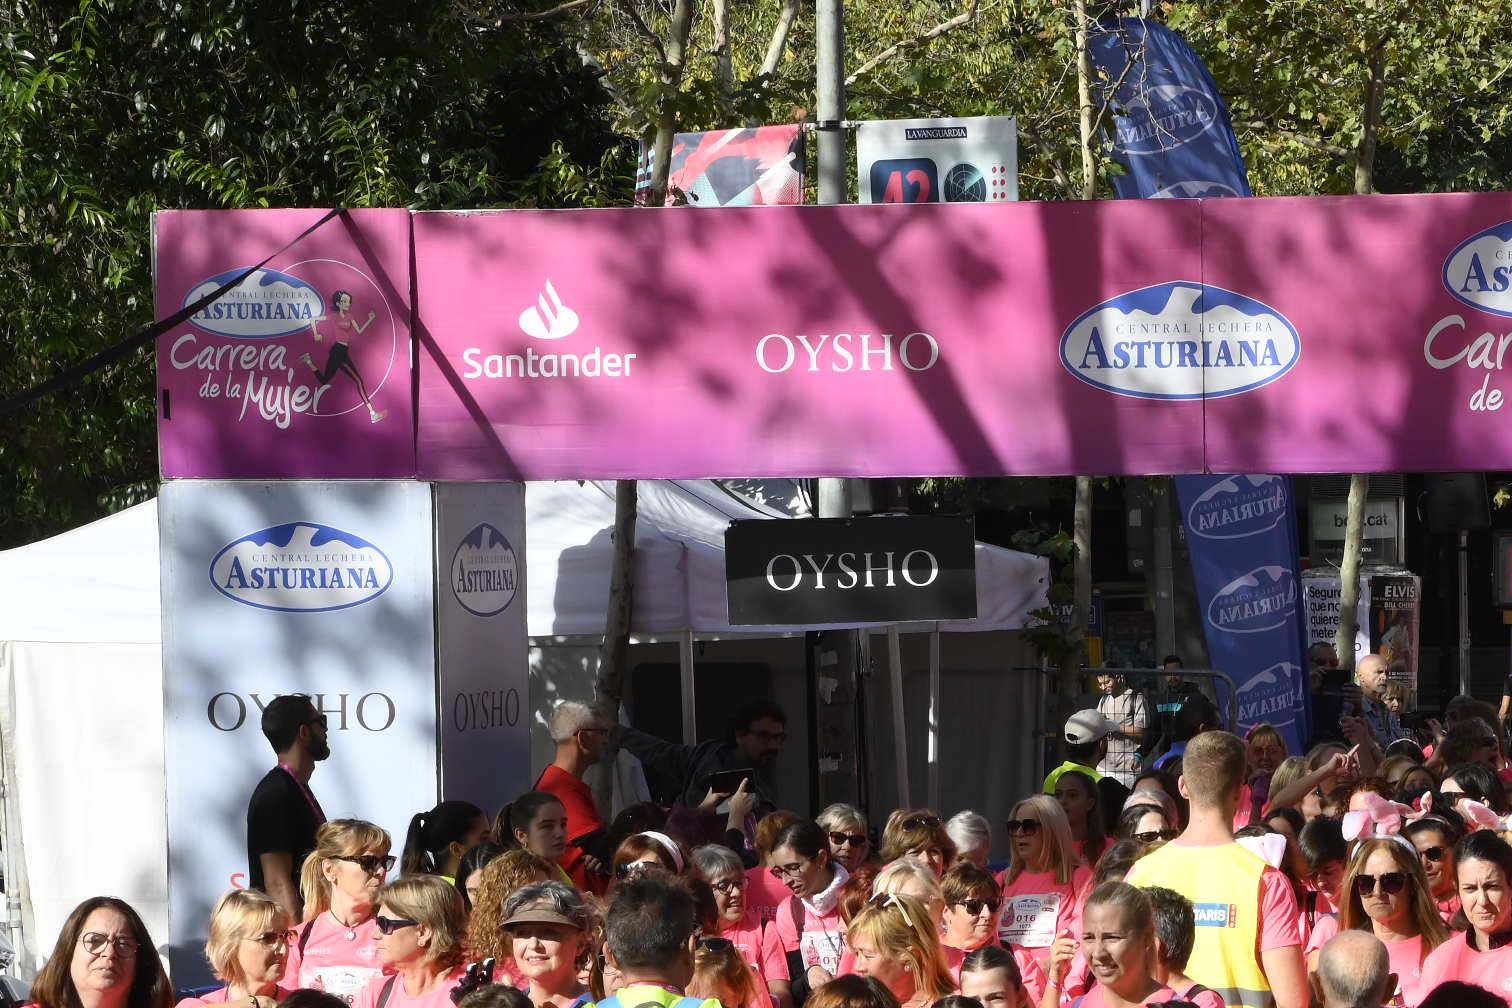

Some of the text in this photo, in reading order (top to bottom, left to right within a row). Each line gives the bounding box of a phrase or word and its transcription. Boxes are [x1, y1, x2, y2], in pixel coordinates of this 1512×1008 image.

[194, 299, 313, 321] ASTURIANA
[1115, 320, 1274, 335] CENTRAL LECHERA
[170, 333, 288, 370] Carrera
[463, 347, 637, 379] Santander
[756, 332, 939, 373] OYSHO
[1079, 329, 1281, 369] ASTURIANA
[200, 368, 332, 429] de la Mujer
[1469, 373, 1504, 411] de
[223, 555, 380, 590] ASTURIANA
[252, 553, 374, 563] CENTRAL LECHERA
[456, 558, 514, 594] ASTURIANA
[766, 549, 939, 591] OYSHO
[1384, 586, 1416, 598] ELVIS
[207, 692, 396, 732] OHO
[454, 688, 520, 732] OYSHO
[1193, 909, 1226, 922] TARIS
